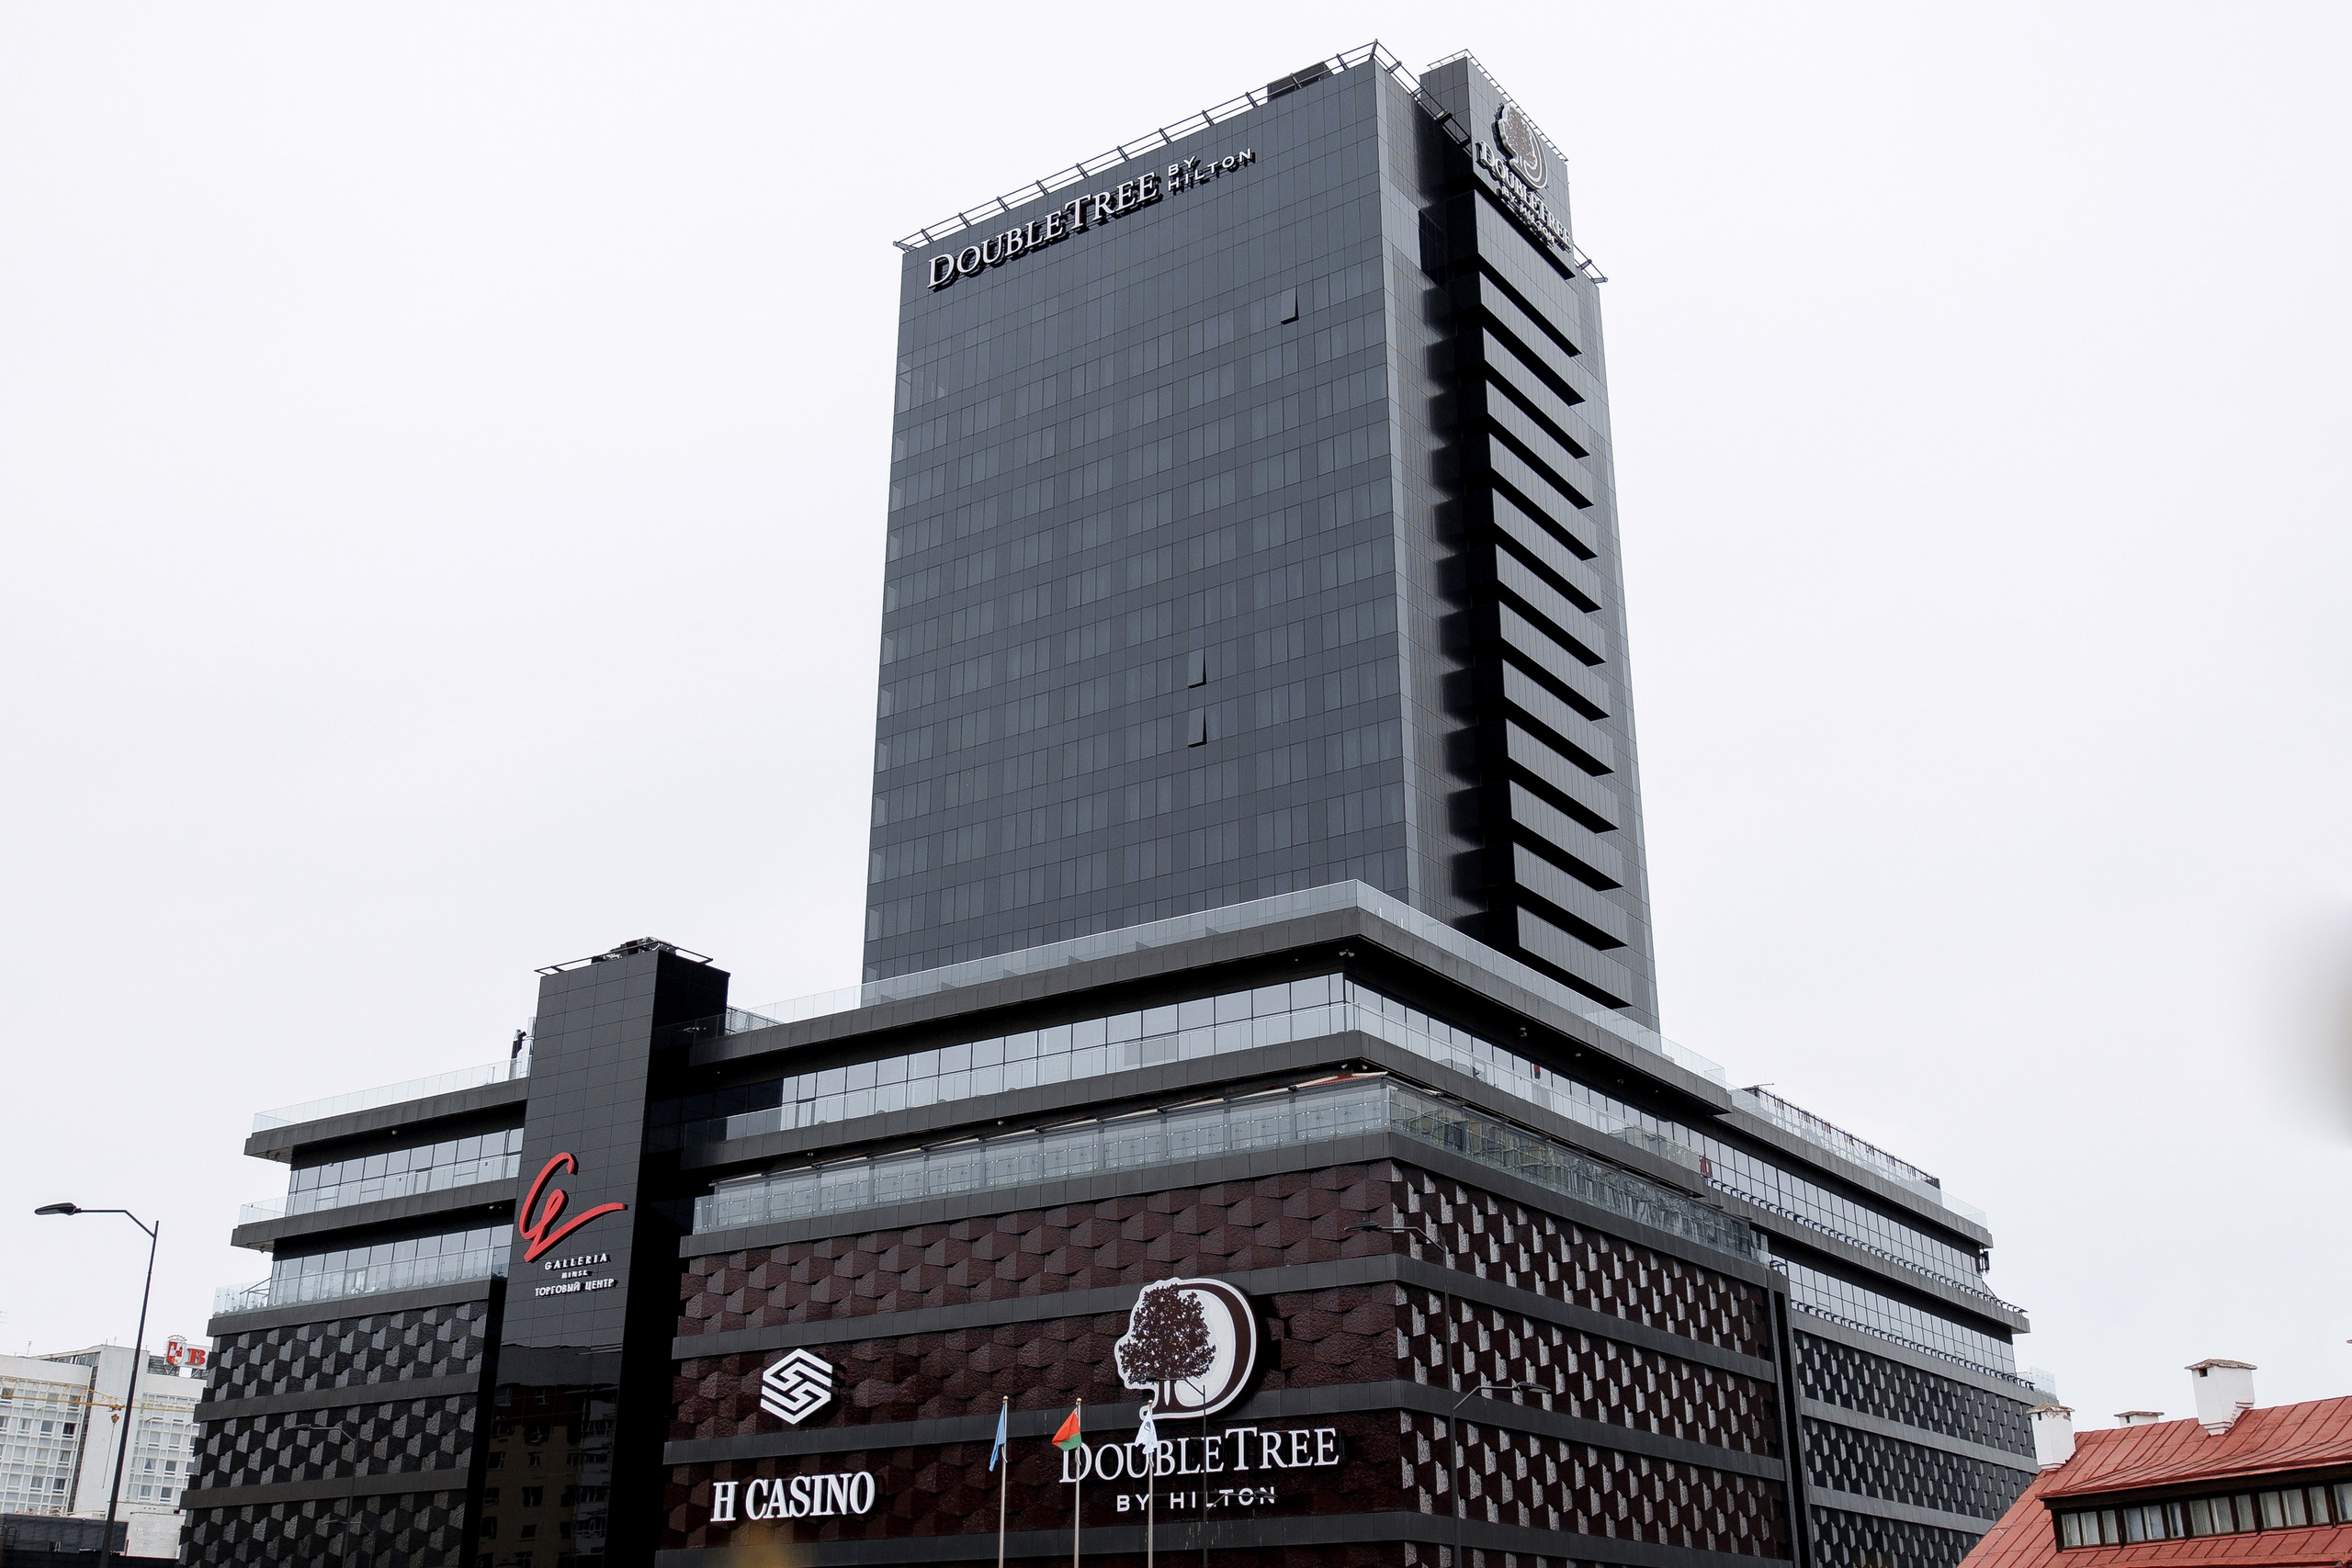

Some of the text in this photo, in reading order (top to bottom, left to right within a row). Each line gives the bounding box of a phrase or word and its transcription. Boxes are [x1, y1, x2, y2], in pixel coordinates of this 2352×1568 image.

[1168, 155, 1197, 177] BY
[1168, 147, 1252, 192] HILTON
[545, 1253, 608, 1270] GALLERIA
[561, 1269, 588, 1280] MINSK
[535, 1278, 615, 1297] ТОРГОВЫЙ ЦЕНТР
[710, 1471, 876, 1522] H CASINO
[1116, 1494, 1150, 1512] BY
